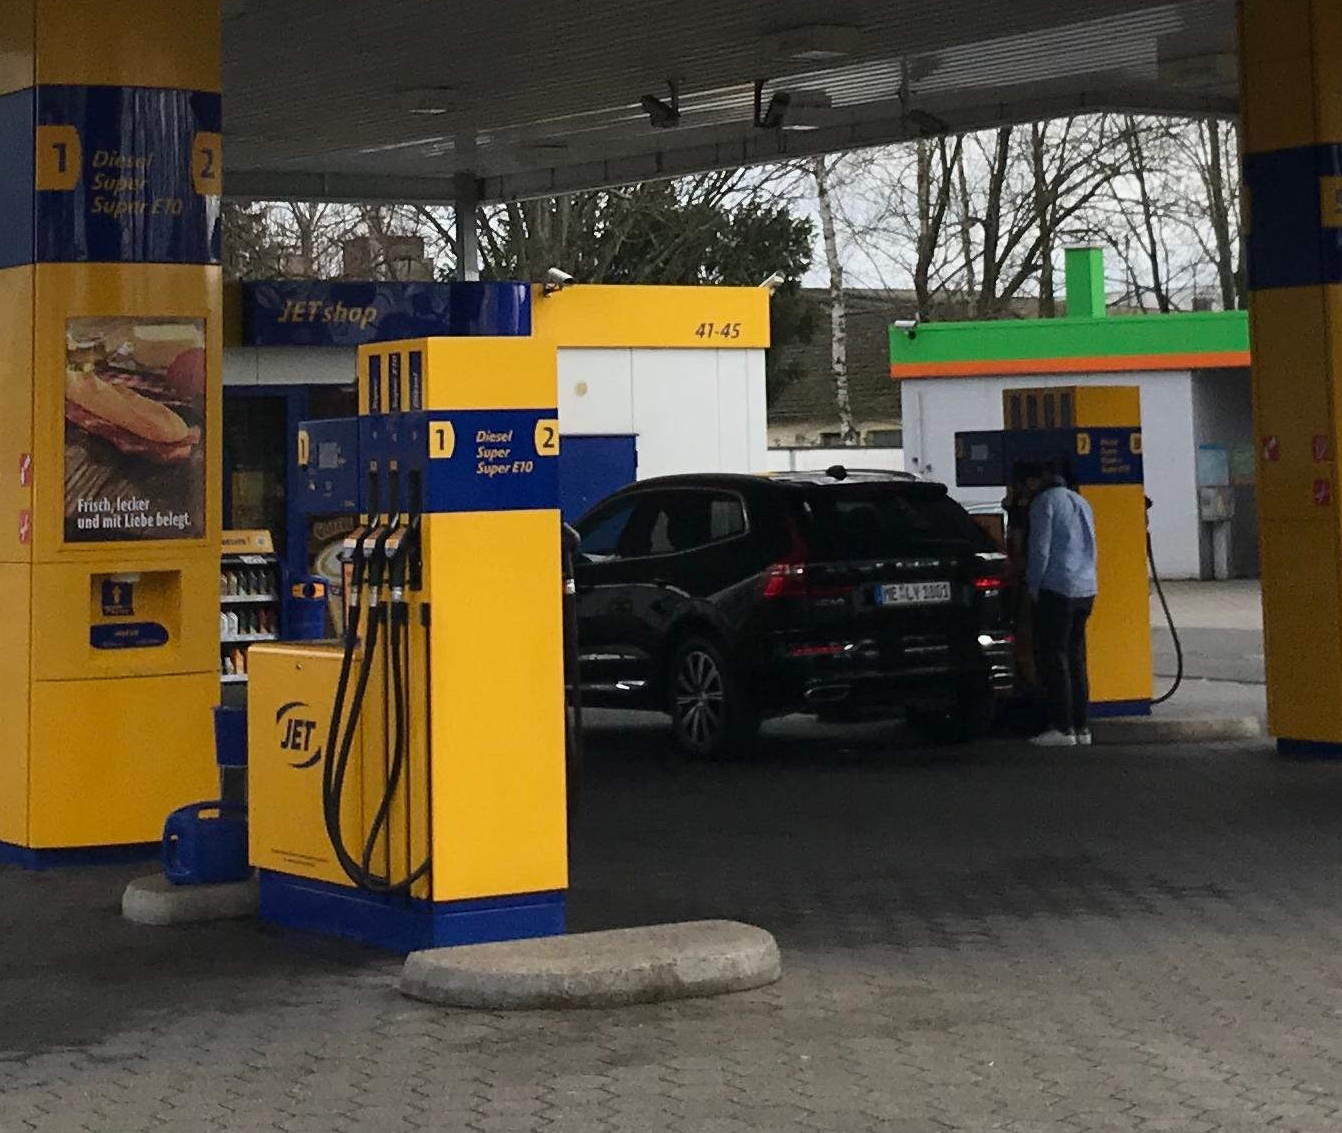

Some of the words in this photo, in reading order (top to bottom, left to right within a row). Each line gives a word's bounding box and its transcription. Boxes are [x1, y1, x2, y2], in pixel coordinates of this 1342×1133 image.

[52, 143, 68, 174] 1
[92, 149, 154, 169] Diesel
[199, 148, 216, 180] 2
[91, 173, 148, 196] Super
[91, 196, 148, 220] Super
[151, 196, 184, 216] E10
[695, 322, 742, 339] 41-45
[435, 429, 445, 451] 1
[476, 429, 514, 443] Diesel
[542, 426, 555, 448] 2
[476, 446, 511, 462] Super
[476, 461, 512, 479] Super
[512, 460, 534, 474] E10
[78, 496, 115, 514] Frisch,
[116, 496, 151, 511] lecker
[77, 513, 100, 529] und
[102, 513, 122, 529] mit
[124, 512, 154, 528] Liebe
[155, 510, 192, 530] belegt.
[281, 718, 317, 752] JET
